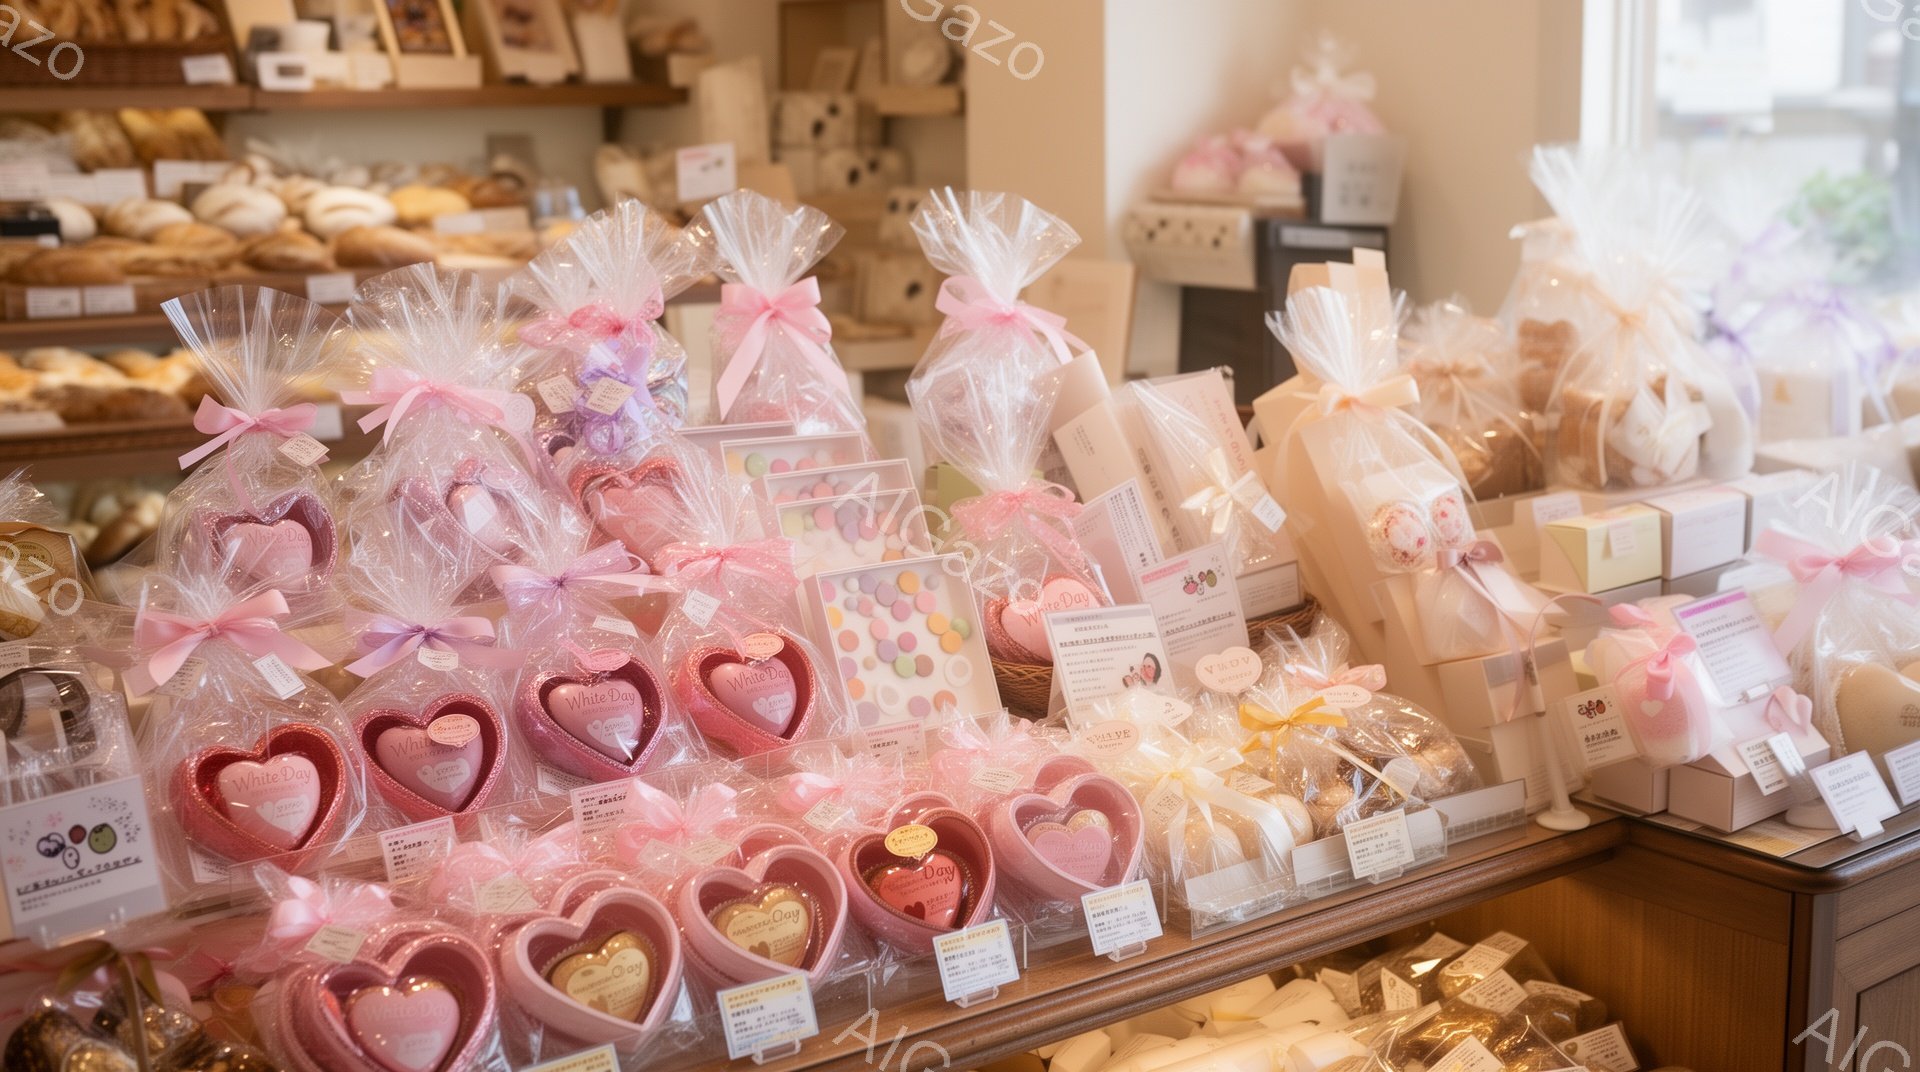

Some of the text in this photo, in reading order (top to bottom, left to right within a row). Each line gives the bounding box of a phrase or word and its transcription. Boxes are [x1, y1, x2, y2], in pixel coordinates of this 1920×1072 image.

[1060, 590, 1090, 609] Day
[726, 665, 790, 693] White Day
[565, 686, 635, 712] White Day
[390, 735, 434, 758] Whit
[232, 765, 312, 794] White Day
